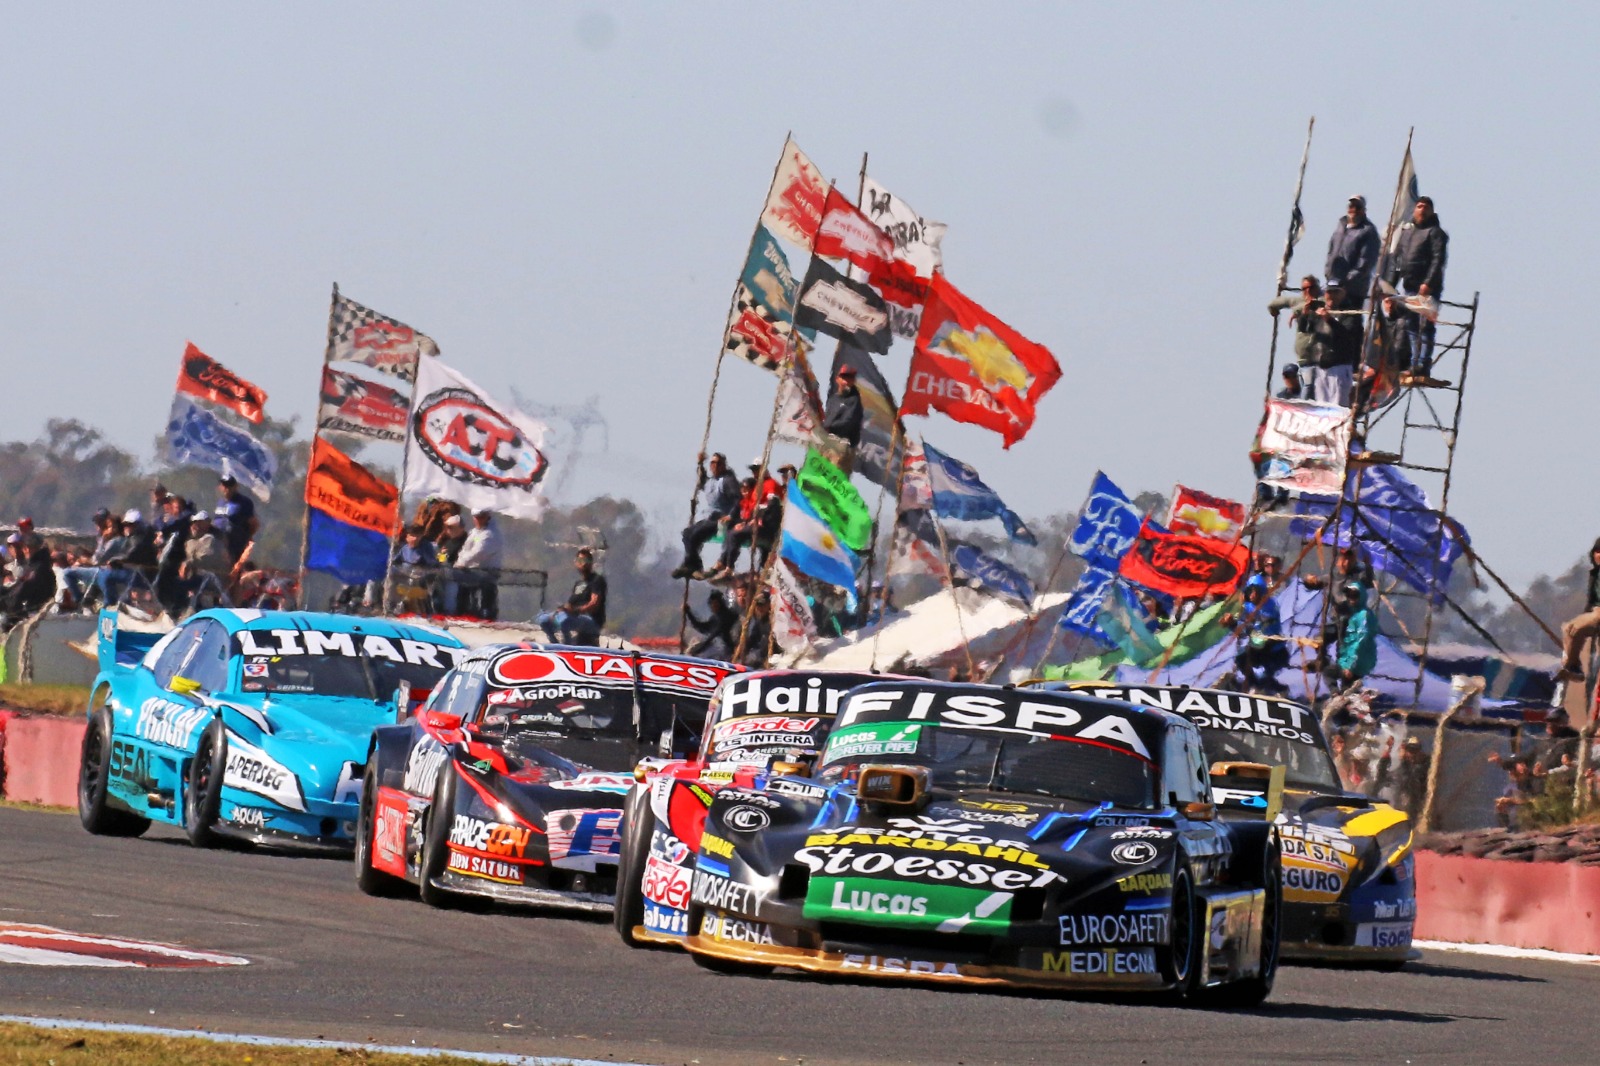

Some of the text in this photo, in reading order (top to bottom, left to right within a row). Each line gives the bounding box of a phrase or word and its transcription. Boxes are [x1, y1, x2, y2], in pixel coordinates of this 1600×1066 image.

[574, 653, 718, 689] TACS
[839, 690, 1152, 759] FISPA
[749, 734, 813, 745] INTEGRA
[831, 731, 878, 750] Lucas
[884, 741, 912, 753] PIPE
[867, 775, 893, 787] WIX
[1094, 817, 1150, 827] COLLINO
[804, 833, 1050, 870] BARDAHL
[1281, 840, 1307, 857] DA
[450, 851, 520, 880] DON SATUR
[793, 845, 1059, 890] Stoessel
[830, 881, 928, 917] Lucas
[1058, 914, 1169, 945] EUROSAFETY
[840, 954, 964, 978] FISPA
[1041, 946, 1156, 978] MEDITECNA
